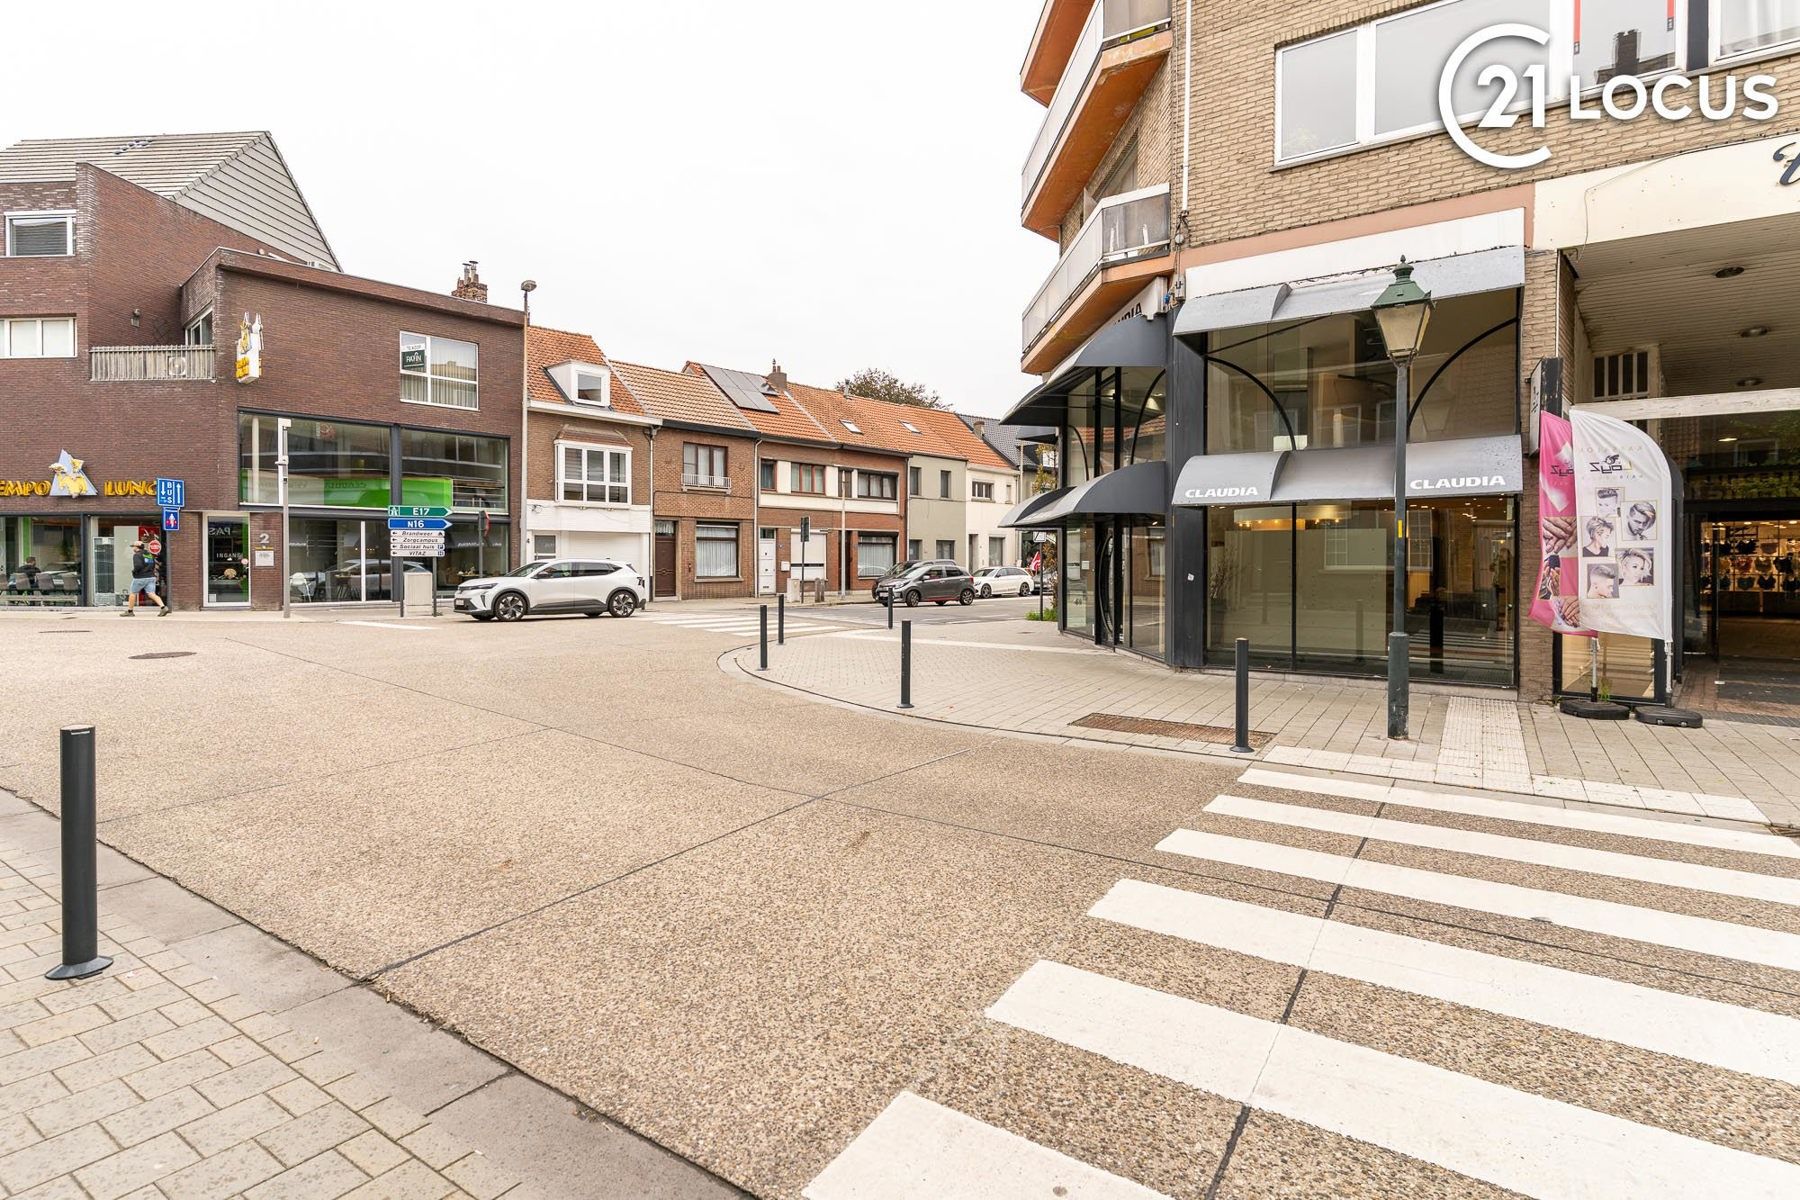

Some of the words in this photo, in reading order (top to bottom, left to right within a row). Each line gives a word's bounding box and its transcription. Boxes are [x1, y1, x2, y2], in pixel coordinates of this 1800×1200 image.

[1409, 474, 1506, 490] CLAUDIA
[1184, 486, 1259, 499] CLAUDIA
[412, 507, 430, 516] E17
[407, 520, 425, 528] N16
[259, 532, 270, 544] 2
